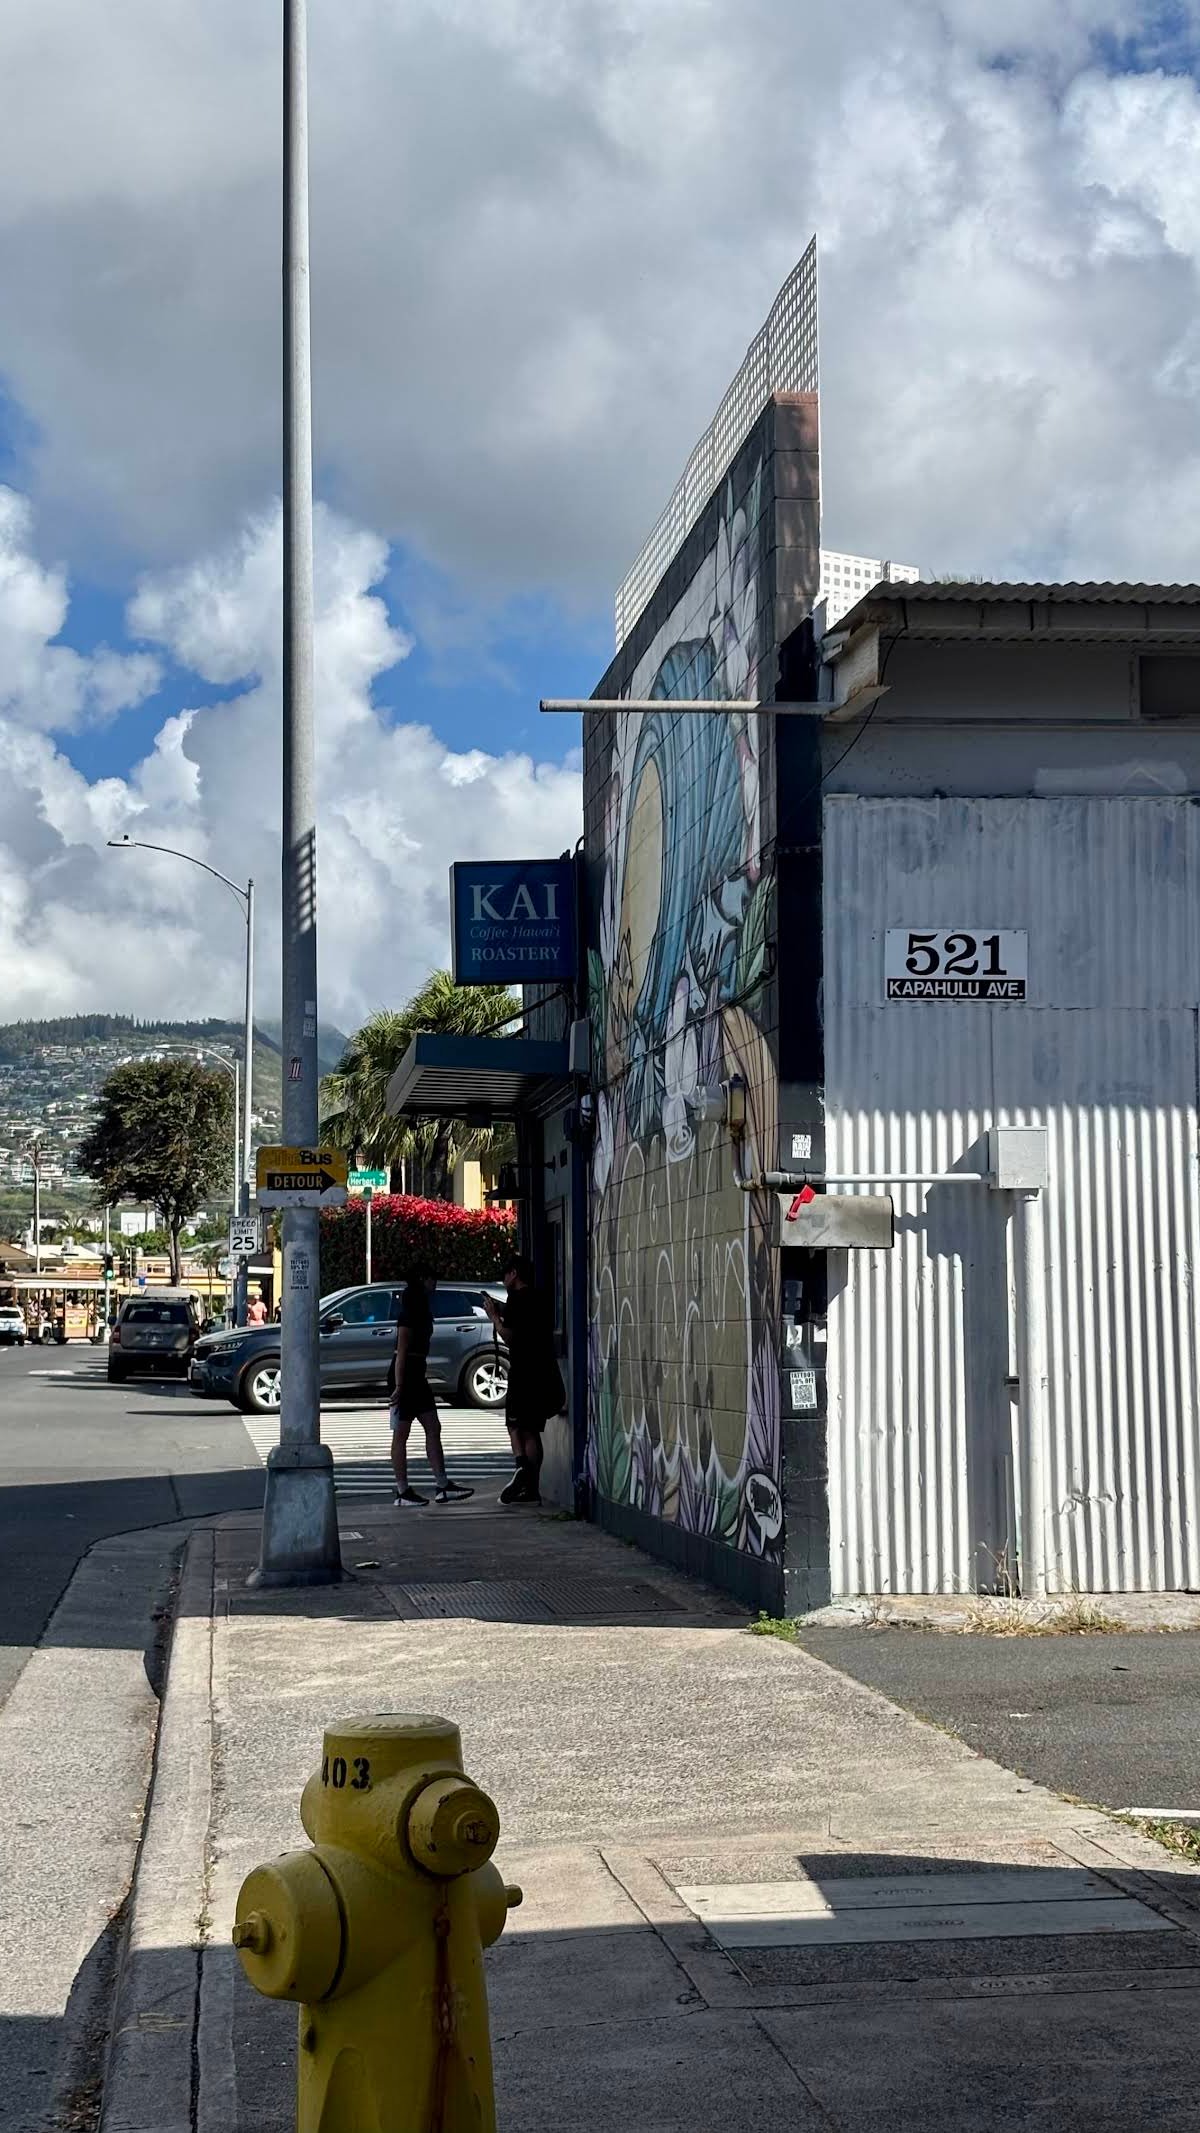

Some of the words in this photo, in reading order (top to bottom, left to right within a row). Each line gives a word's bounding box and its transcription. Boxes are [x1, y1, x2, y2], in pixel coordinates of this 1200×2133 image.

[469, 883, 560, 921] KAI
[470, 925, 509, 941] Coffee
[471, 946, 561, 961] ROASTERY
[905, 933, 1007, 976] 521
[889, 980, 980, 996] KAPAHULU
[986, 982, 1023, 997] AVE.
[792, 1151, 811, 1159] MILK
[274, 1175, 323, 1188] DETOUR
[232, 1236, 255, 1250] 25
